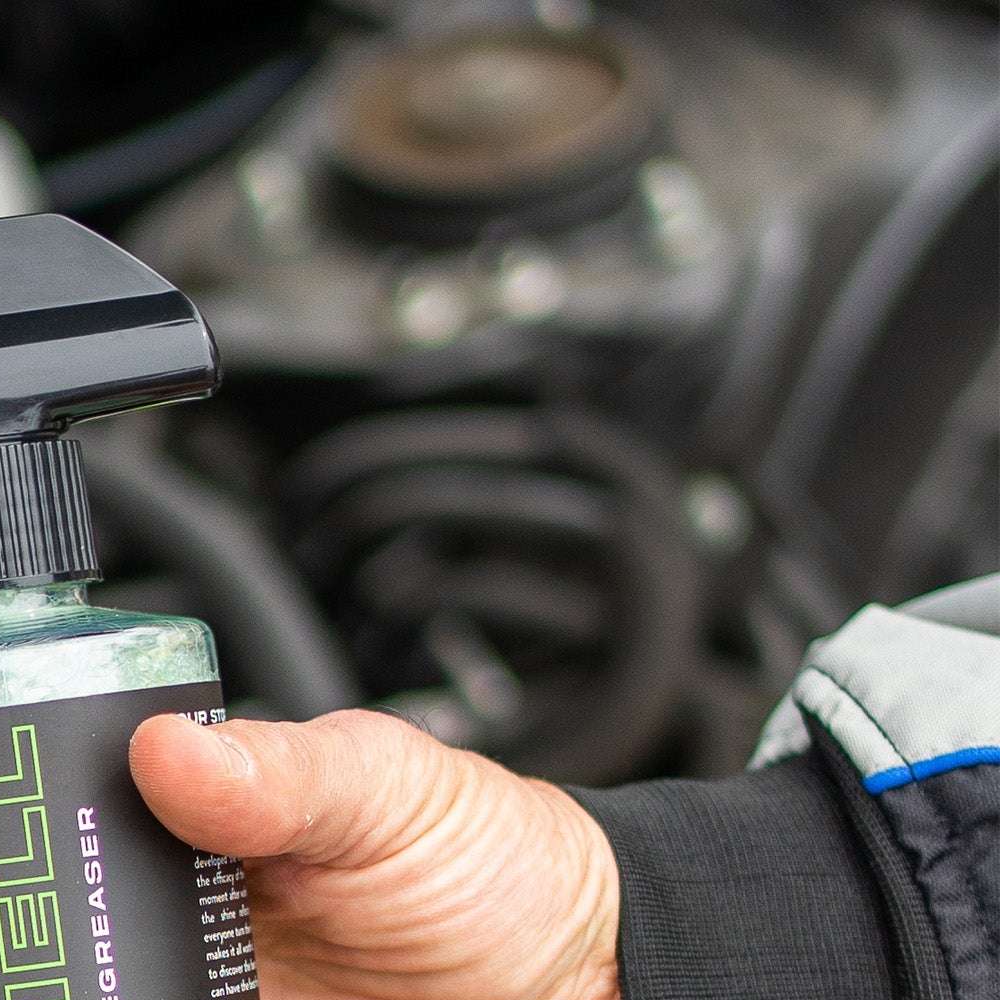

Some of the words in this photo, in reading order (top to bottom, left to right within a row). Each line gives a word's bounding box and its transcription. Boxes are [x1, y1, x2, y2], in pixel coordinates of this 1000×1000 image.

[196, 874, 210, 888] the
[199, 891, 229, 906] moment
[201, 911, 215, 924] the
[203, 929, 235, 944] everyone
[206, 946, 230, 961] makes
[208, 969, 218, 980] to
[219, 964, 244, 978] discover
[210, 987, 225, 998] can
[225, 982, 241, 995] have
